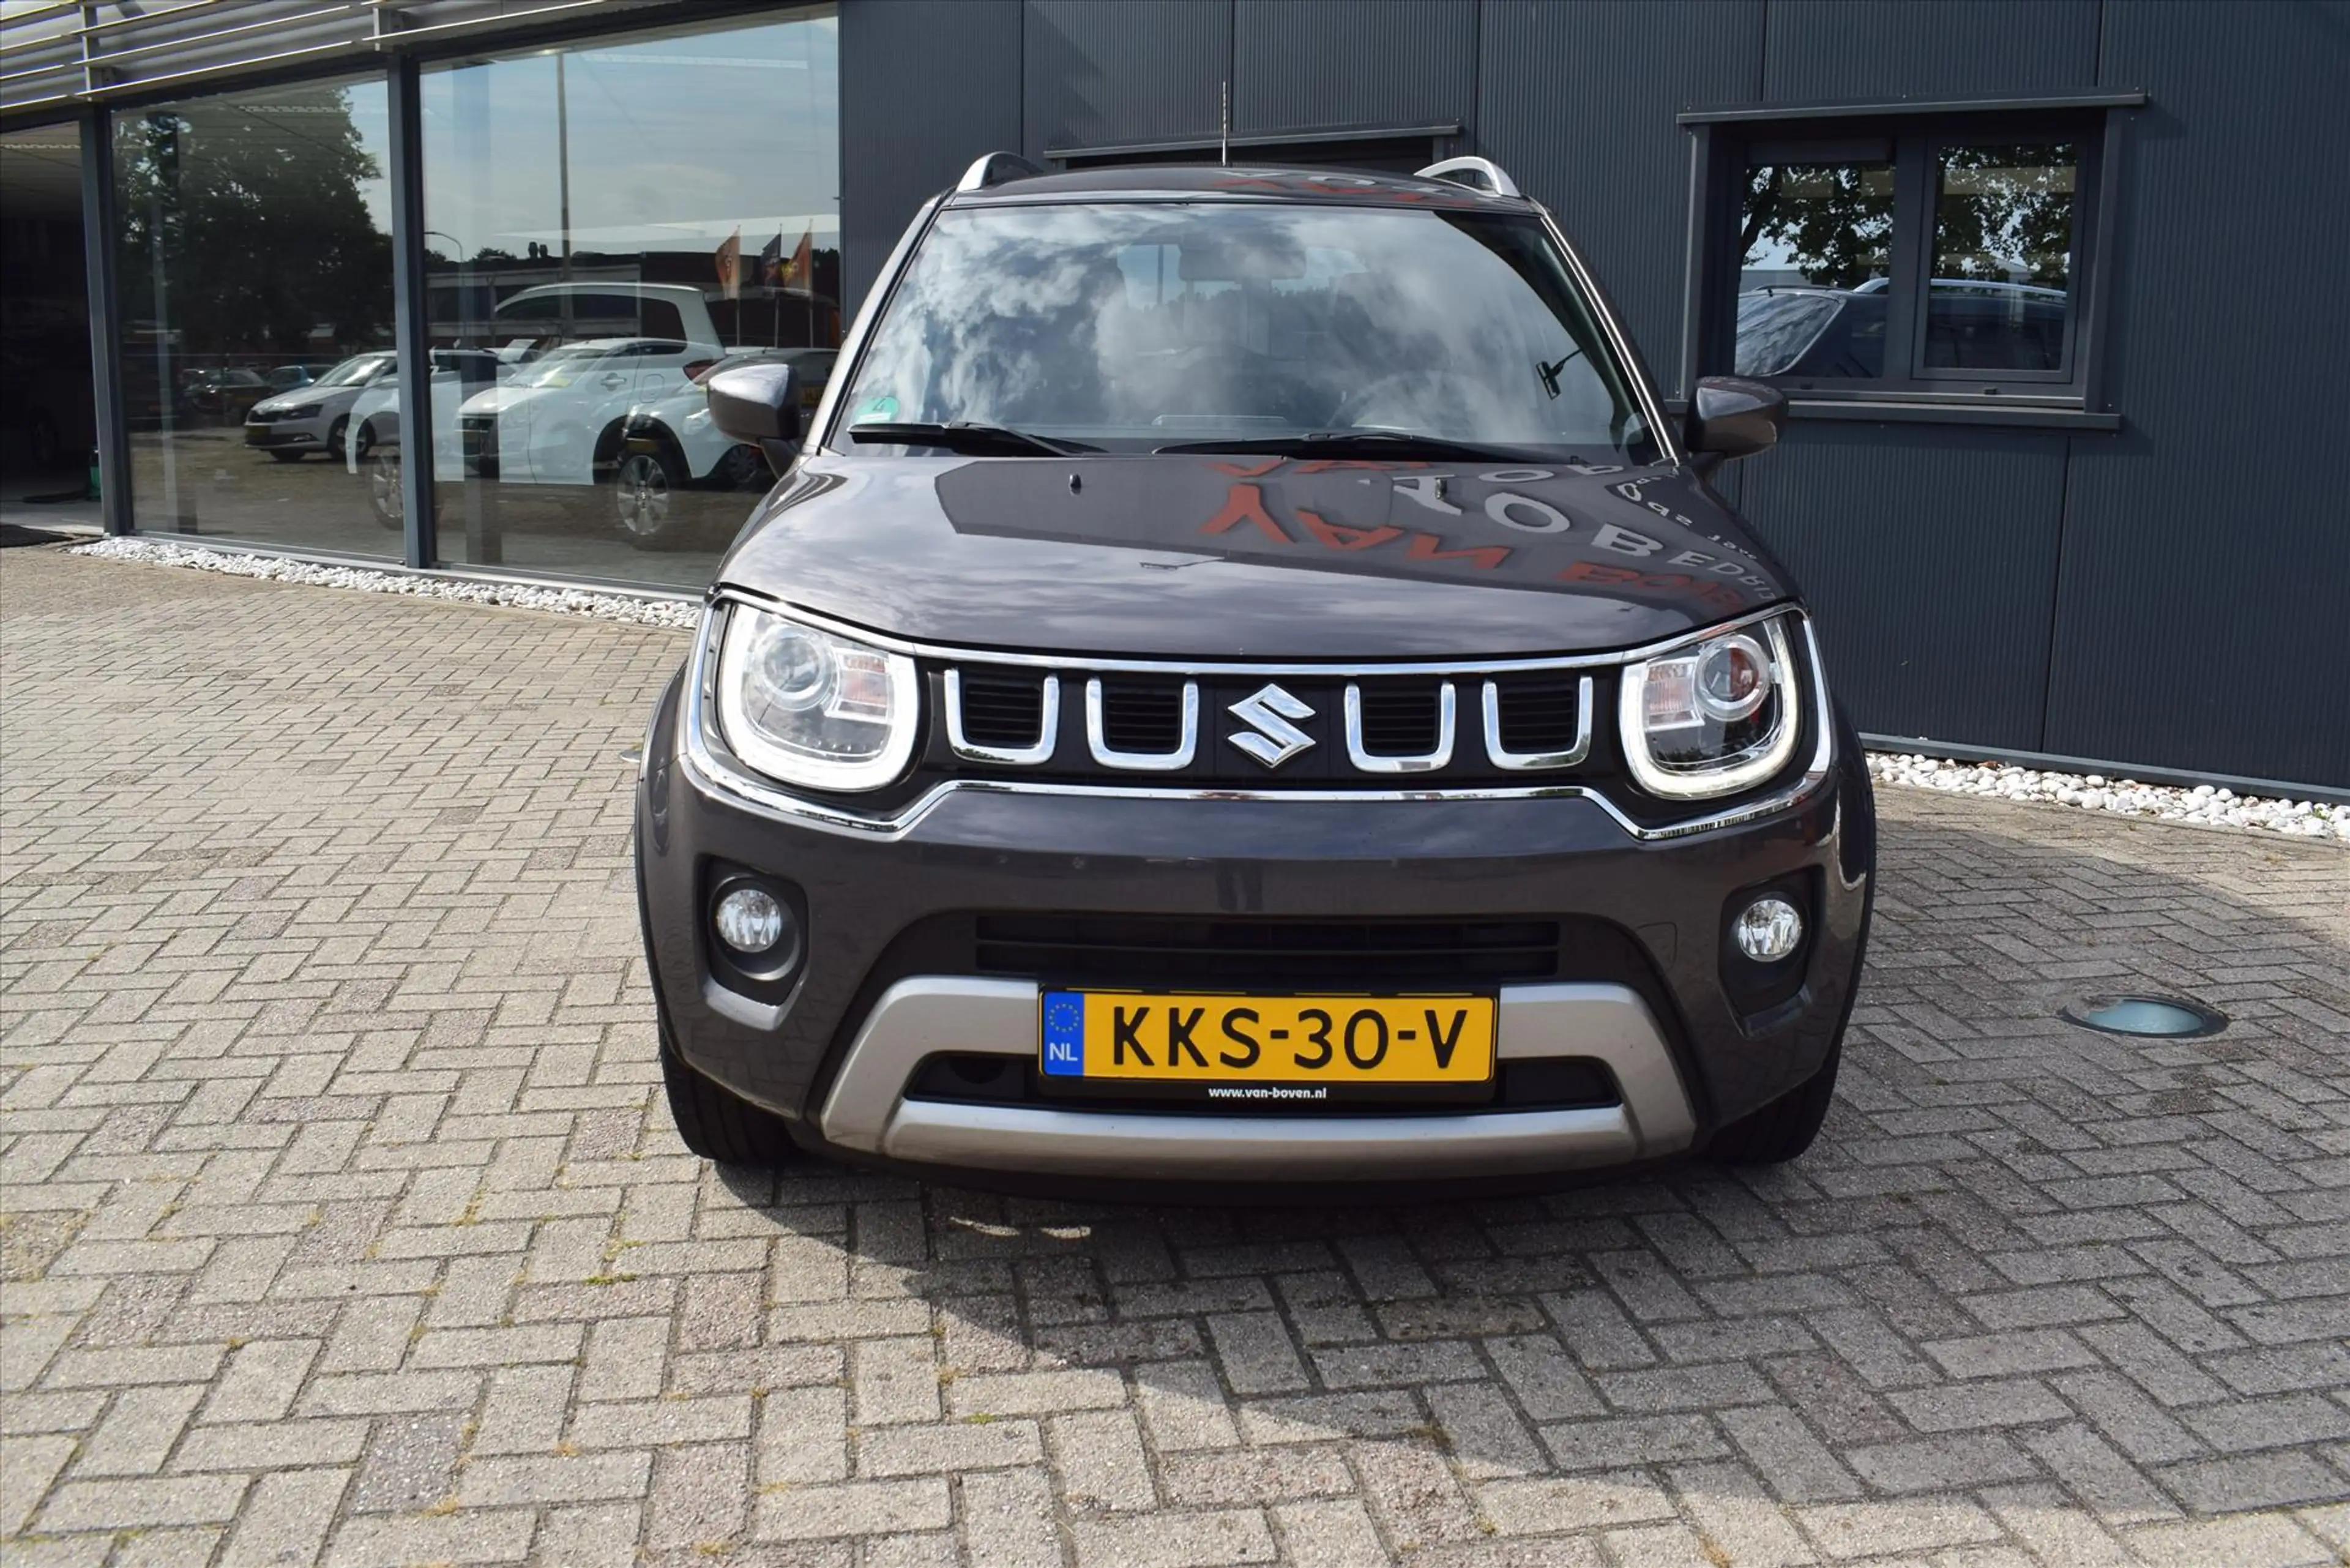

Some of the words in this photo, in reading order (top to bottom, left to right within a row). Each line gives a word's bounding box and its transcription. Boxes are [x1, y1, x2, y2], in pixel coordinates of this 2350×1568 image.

[1113, 1006, 1469, 1070] KKS-30-V
[1049, 1042, 1078, 1062] NL
[1208, 1087, 1327, 1099] www.van-boven.nl
